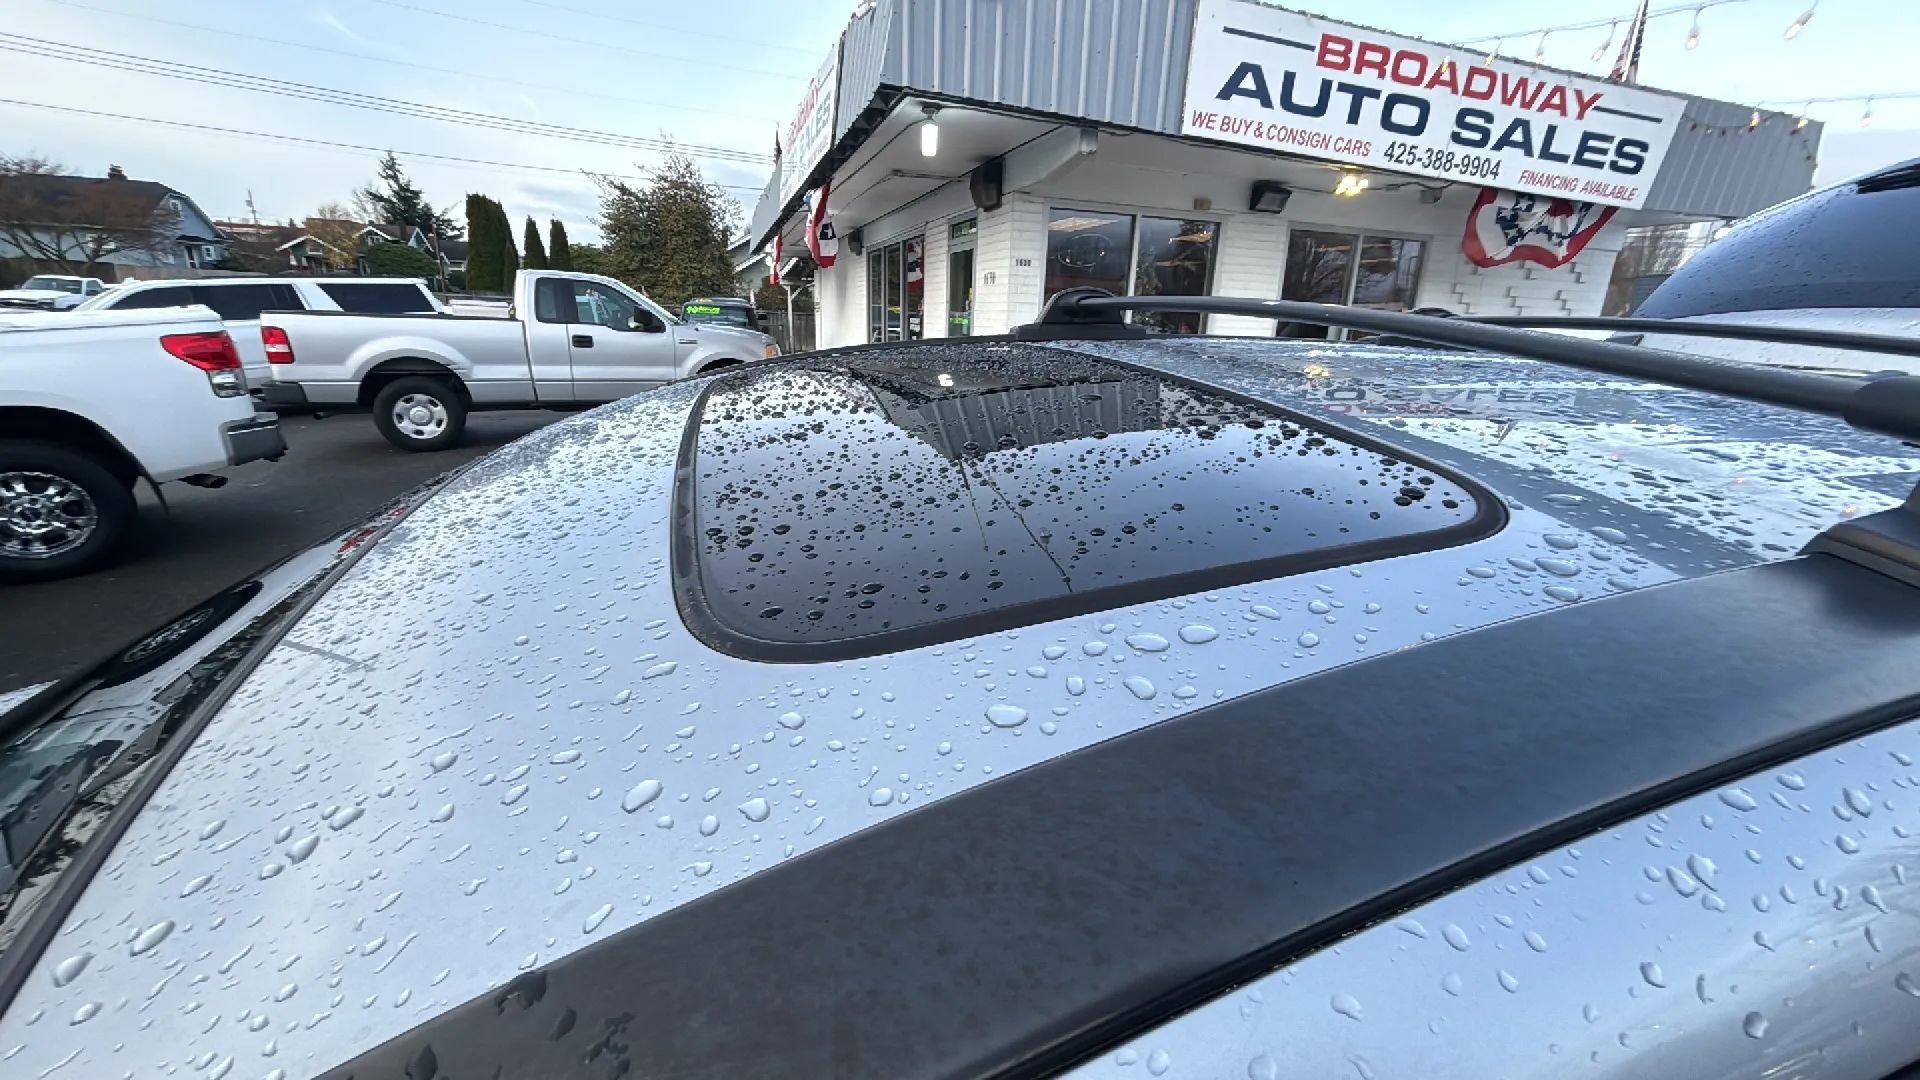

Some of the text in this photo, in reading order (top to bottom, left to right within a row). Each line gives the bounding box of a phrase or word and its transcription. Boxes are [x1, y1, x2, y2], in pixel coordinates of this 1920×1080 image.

[1316, 33, 1604, 120] BROADWAY
[1192, 110, 1372, 158] WE BUY & CONSIGN CARS
[1215, 61, 1649, 175] AUTO SALES
[1383, 140, 1502, 180] 425-388-9904
[1519, 169, 1637, 201] FINANCING AVAILABLE
